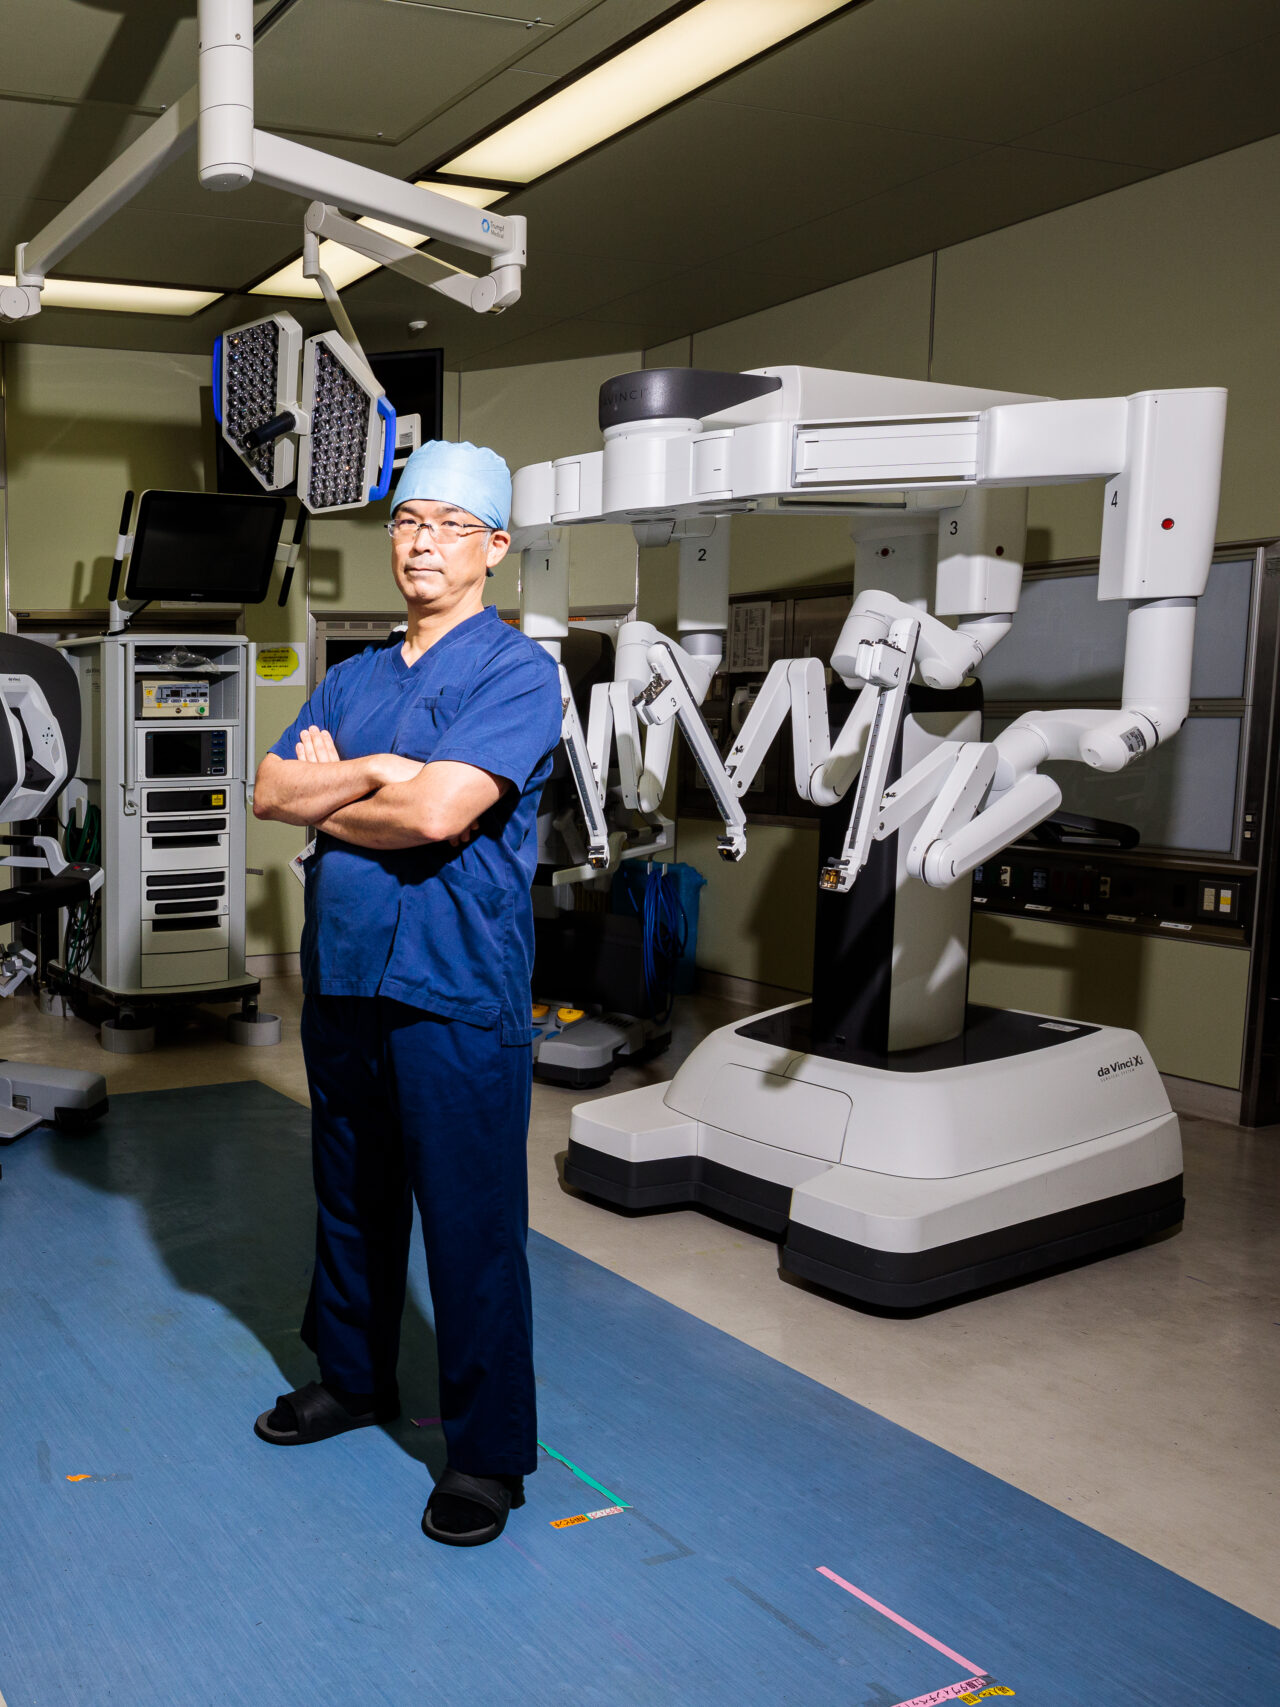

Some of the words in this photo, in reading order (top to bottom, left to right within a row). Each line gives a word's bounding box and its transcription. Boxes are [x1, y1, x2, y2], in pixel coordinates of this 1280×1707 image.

[1110, 491, 1118, 508] 4
[949, 520, 958, 536] 3
[697, 548, 707, 562] 2
[544, 558, 550, 572] 1
[893, 667, 900, 679] 4
[1097, 1066, 1111, 1077] da
[1110, 1057, 1134, 1072] Vinci
[1132, 1055, 1144, 1067] Xi
